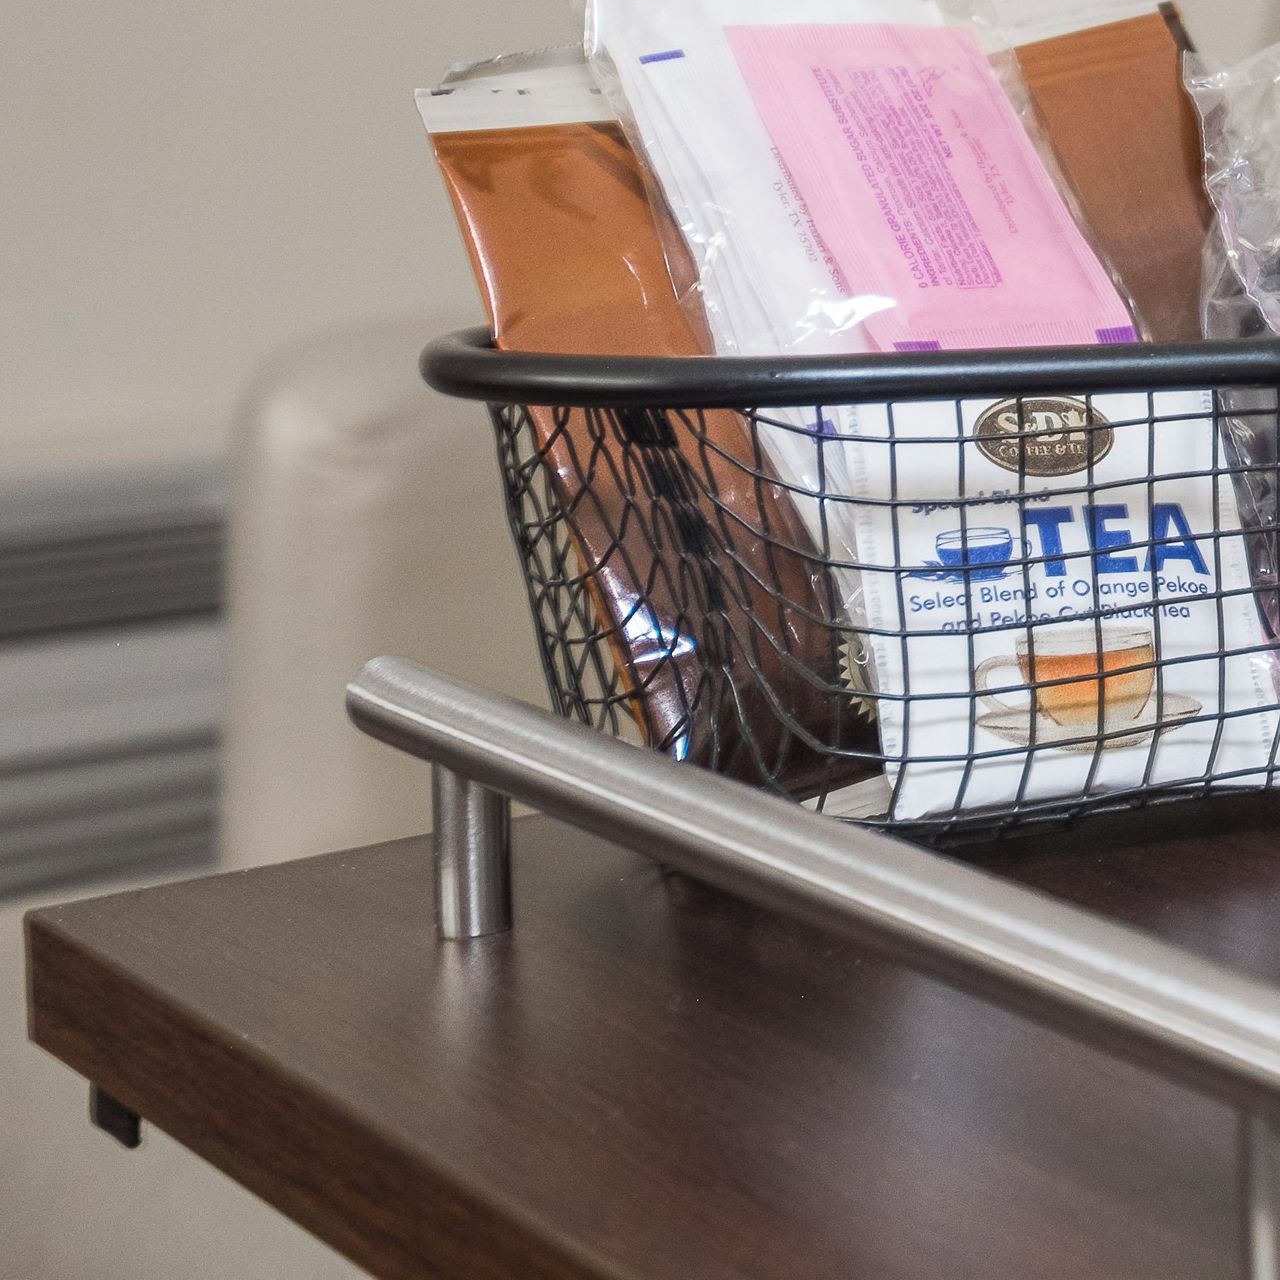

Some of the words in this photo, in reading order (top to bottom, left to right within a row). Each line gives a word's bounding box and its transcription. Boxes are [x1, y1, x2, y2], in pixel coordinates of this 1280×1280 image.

[809, 66, 849, 124] SUBSTITUTE
[840, 126, 868, 161] SUGAR
[937, 139, 954, 157] NET
[858, 163, 903, 232] GRANULATED
[786, 211, 802, 226] TX
[795, 231, 819, 263] 75702
[893, 233, 926, 279] CALORIE
[826, 267, 848, 292] Sons
[998, 443, 1052, 458] COFEE
[1019, 502, 1211, 577] TEA
[910, 591, 974, 612] Selec
[980, 582, 1038, 603] Blend
[1046, 580, 1066, 598] of
[1072, 579, 1150, 597] Oange
[1155, 576, 1208, 593] Pekoe
[942, 612, 982, 631] and
